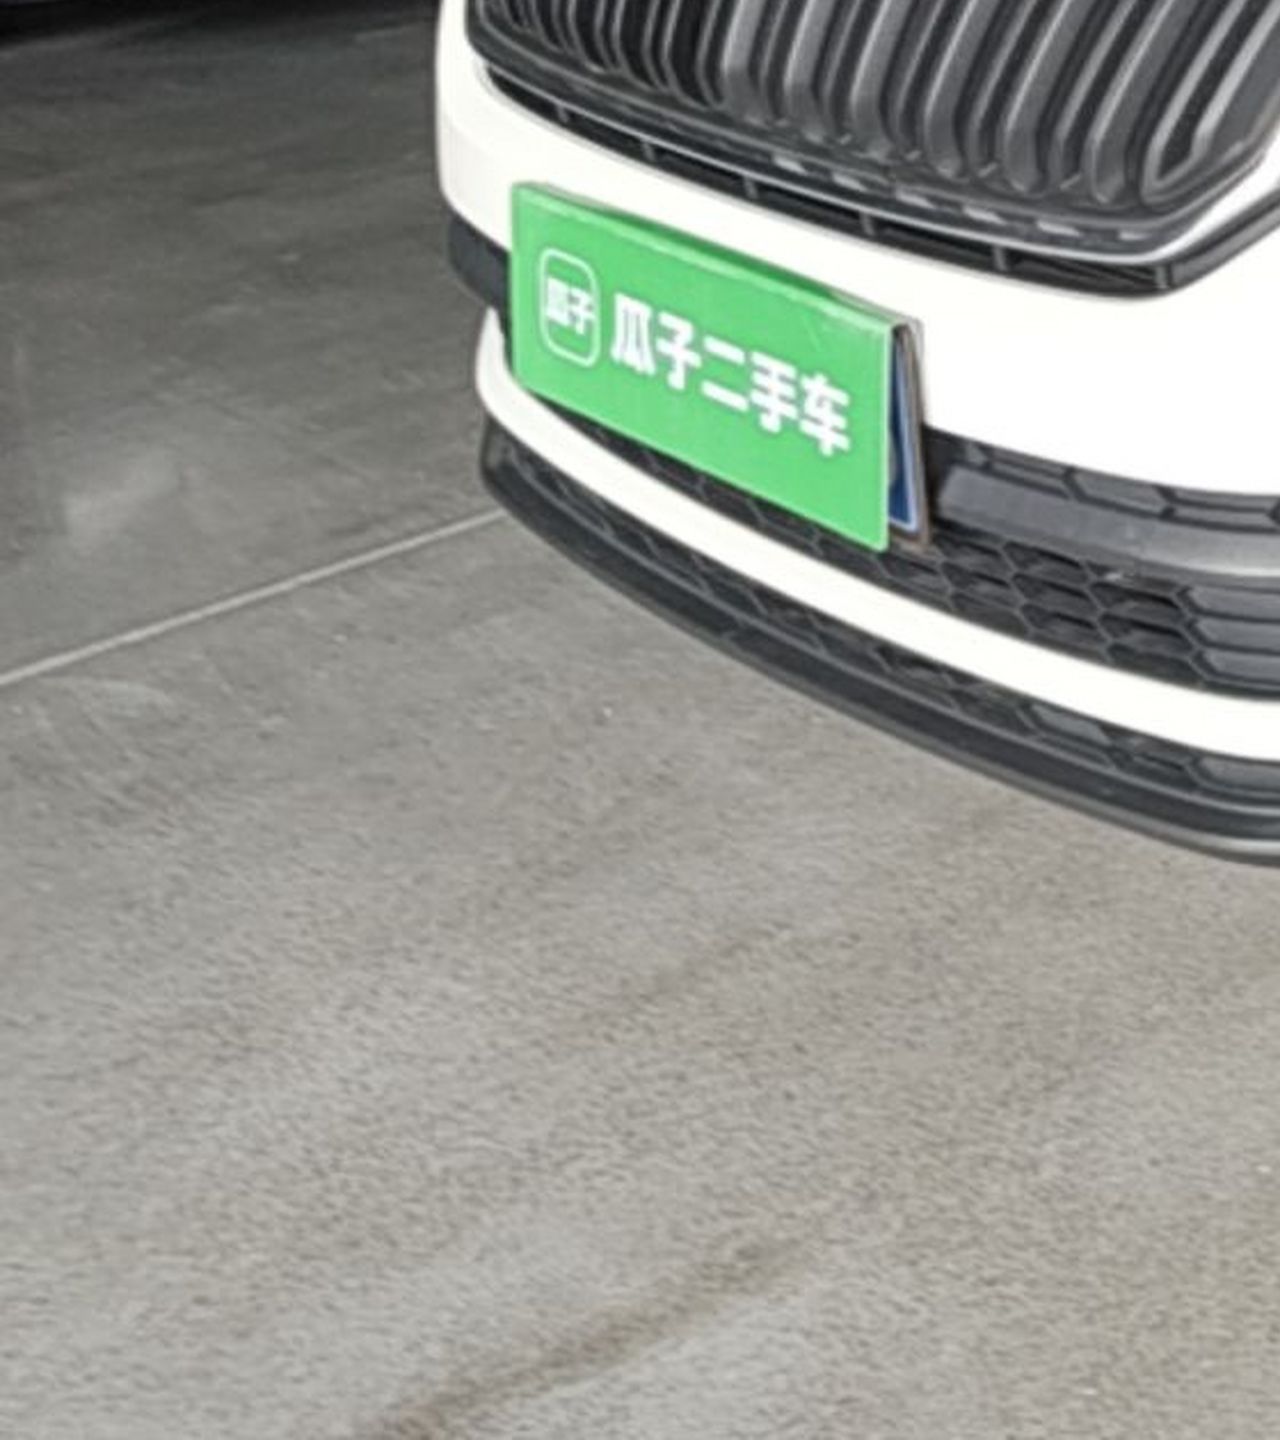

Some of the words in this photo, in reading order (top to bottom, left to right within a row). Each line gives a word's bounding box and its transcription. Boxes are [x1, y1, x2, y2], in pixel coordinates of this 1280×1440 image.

[610, 293, 850, 456] 瓜子二手车
